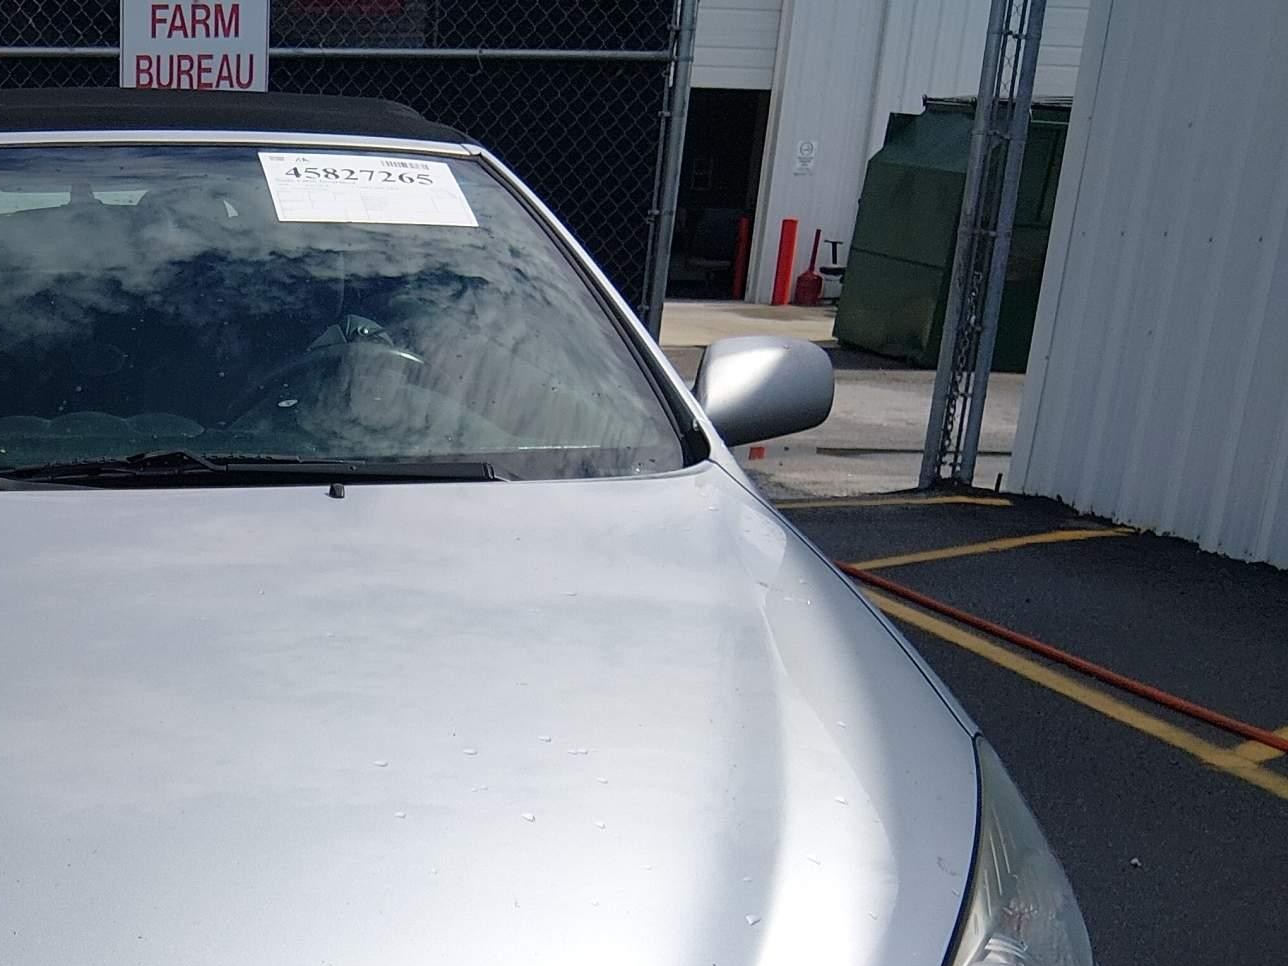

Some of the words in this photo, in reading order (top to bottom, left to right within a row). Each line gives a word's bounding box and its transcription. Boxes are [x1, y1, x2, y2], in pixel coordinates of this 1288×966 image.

[150, 3, 240, 39] FARM
[135, 54, 254, 90] BUREAU
[285, 166, 434, 186] 45827265
